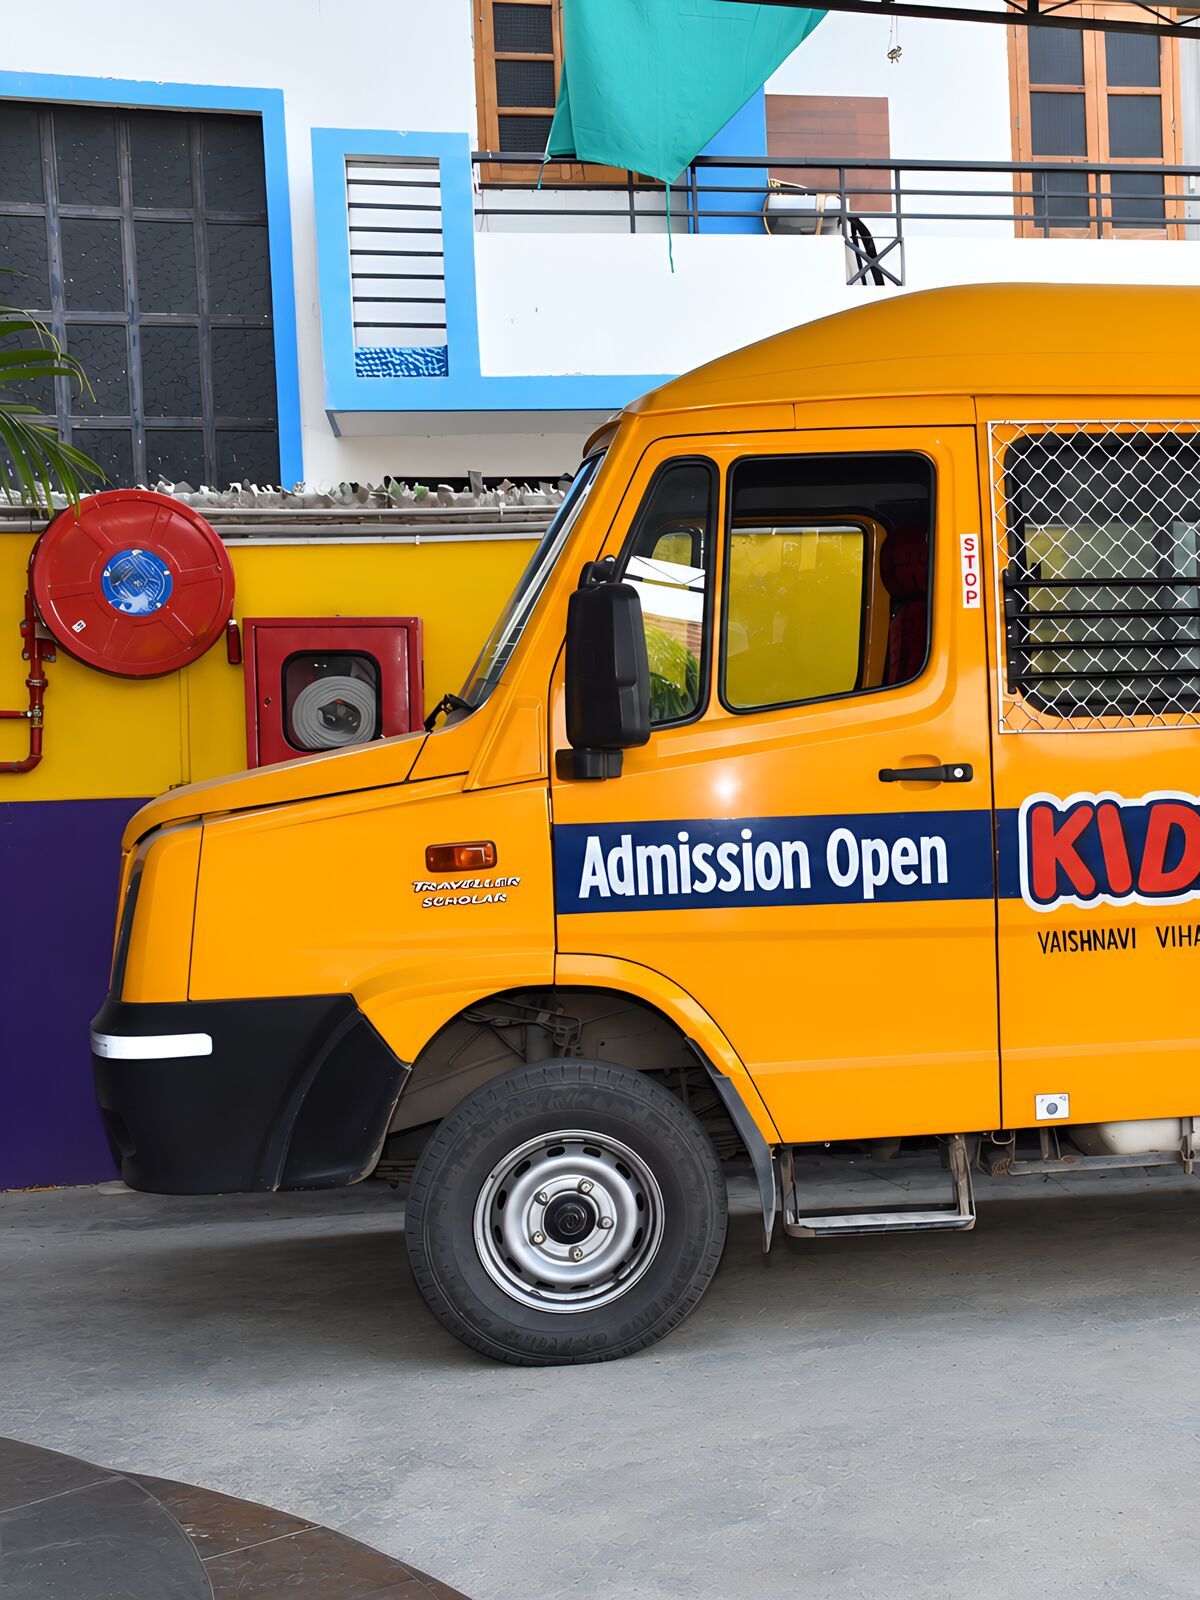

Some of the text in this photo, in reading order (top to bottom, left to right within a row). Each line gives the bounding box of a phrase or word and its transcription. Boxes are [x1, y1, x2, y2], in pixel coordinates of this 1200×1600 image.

[964, 537, 977, 604] STOP
[578, 827, 948, 899] Admission Open
[422, 892, 507, 908] SCHOLAR
[1037, 927, 1137, 955] VAISHNAVI
